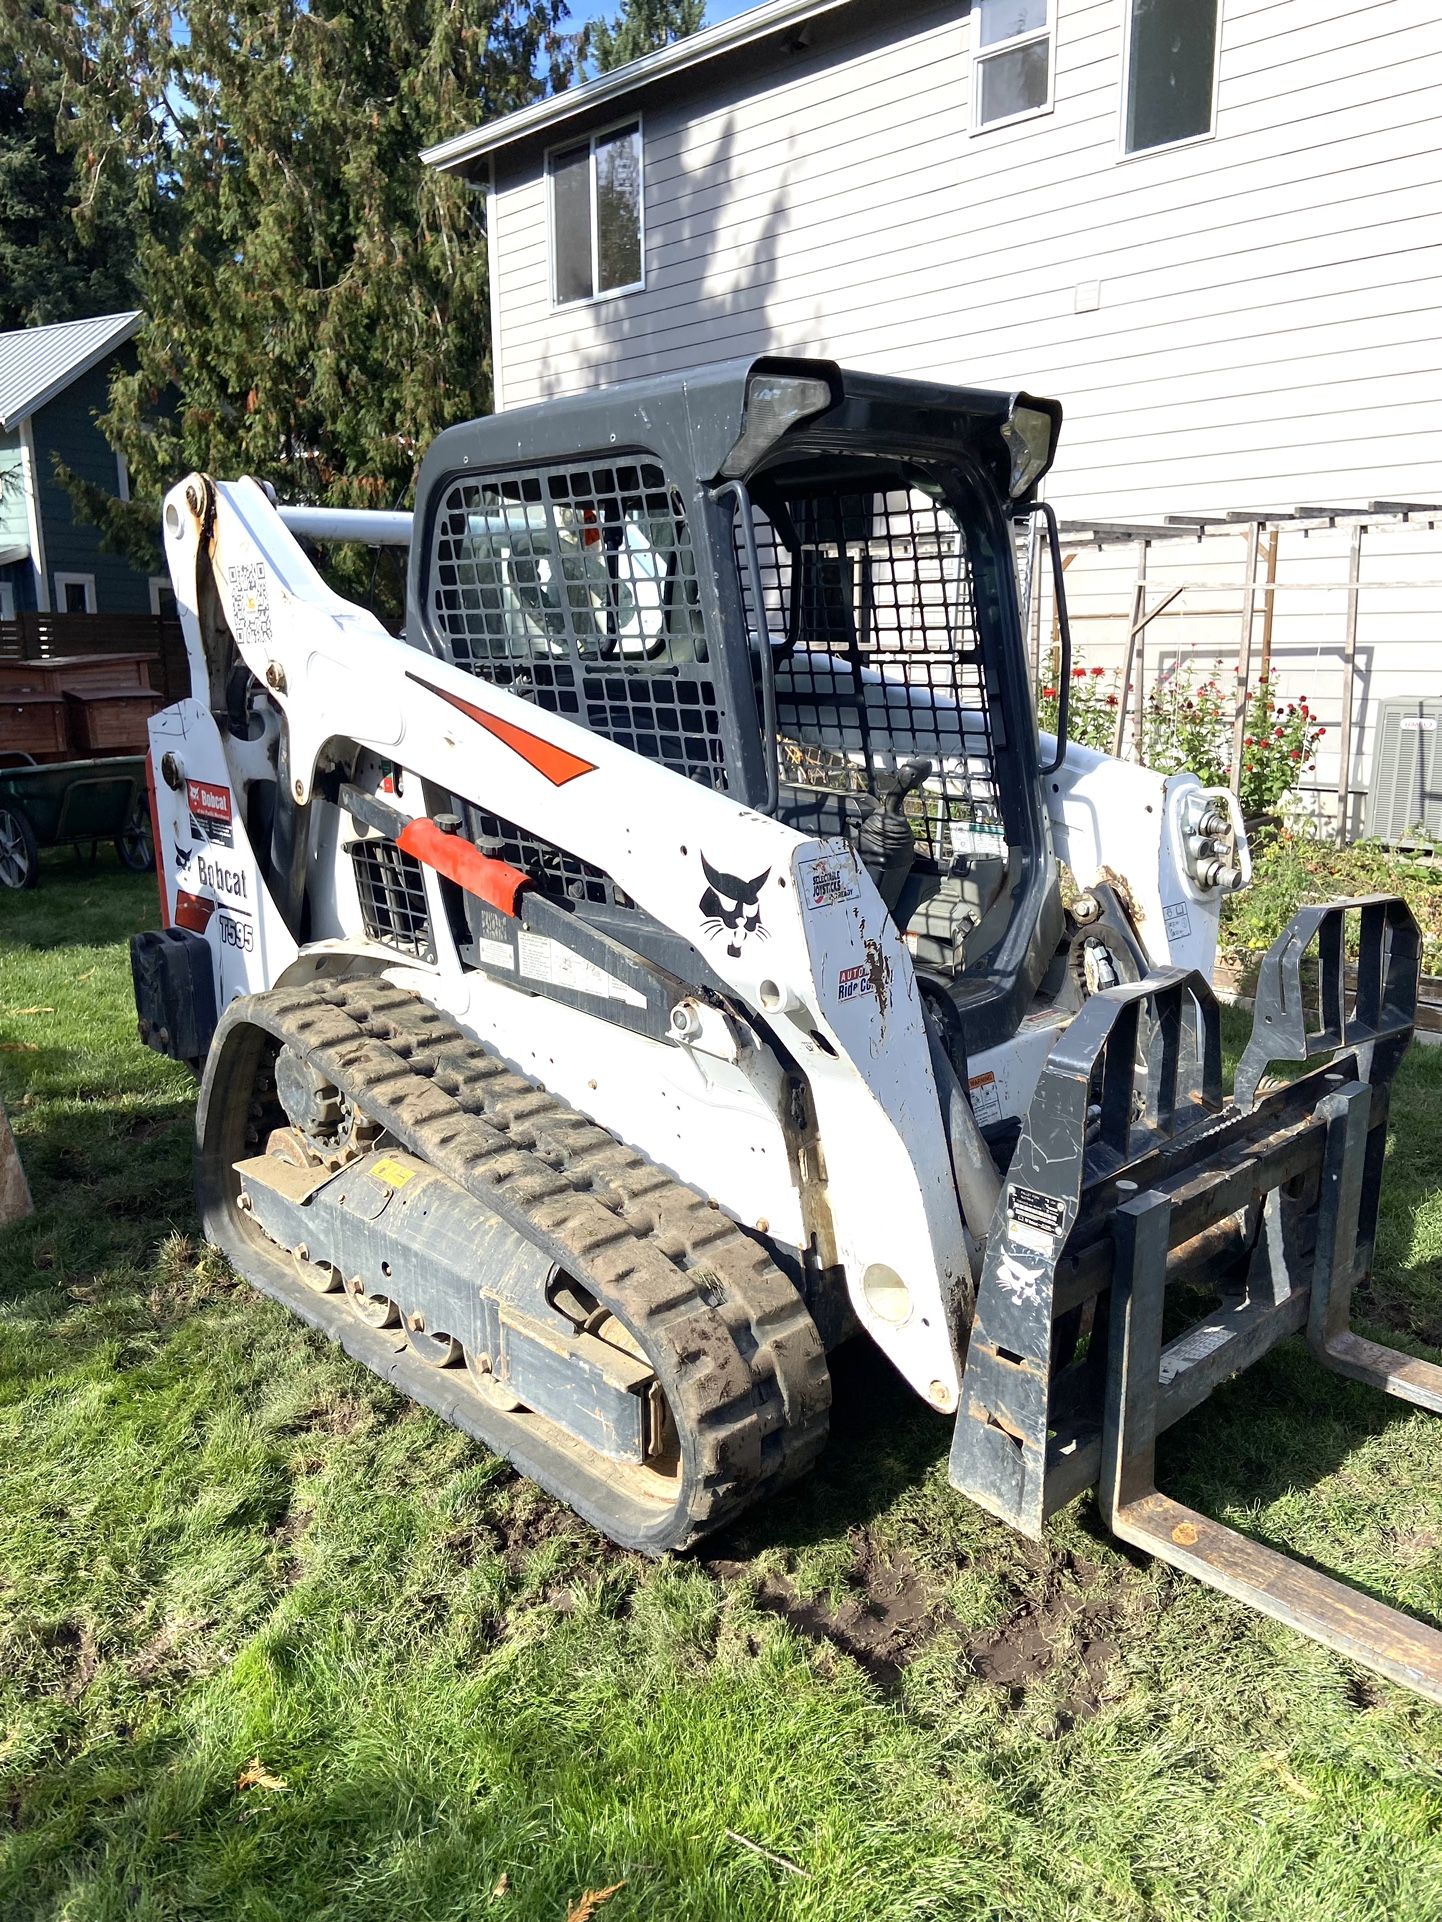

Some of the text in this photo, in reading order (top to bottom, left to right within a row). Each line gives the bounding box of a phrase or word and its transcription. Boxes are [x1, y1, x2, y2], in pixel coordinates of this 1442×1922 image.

[201, 790, 227, 811] Bobcat
[198, 856, 248, 898] Bobcat
[813, 880, 841, 897] JOYSTICKS
[219, 915, 254, 952] T595
[838, 981, 858, 1000] Ride
[970, 1074, 993, 1087] WARNING
